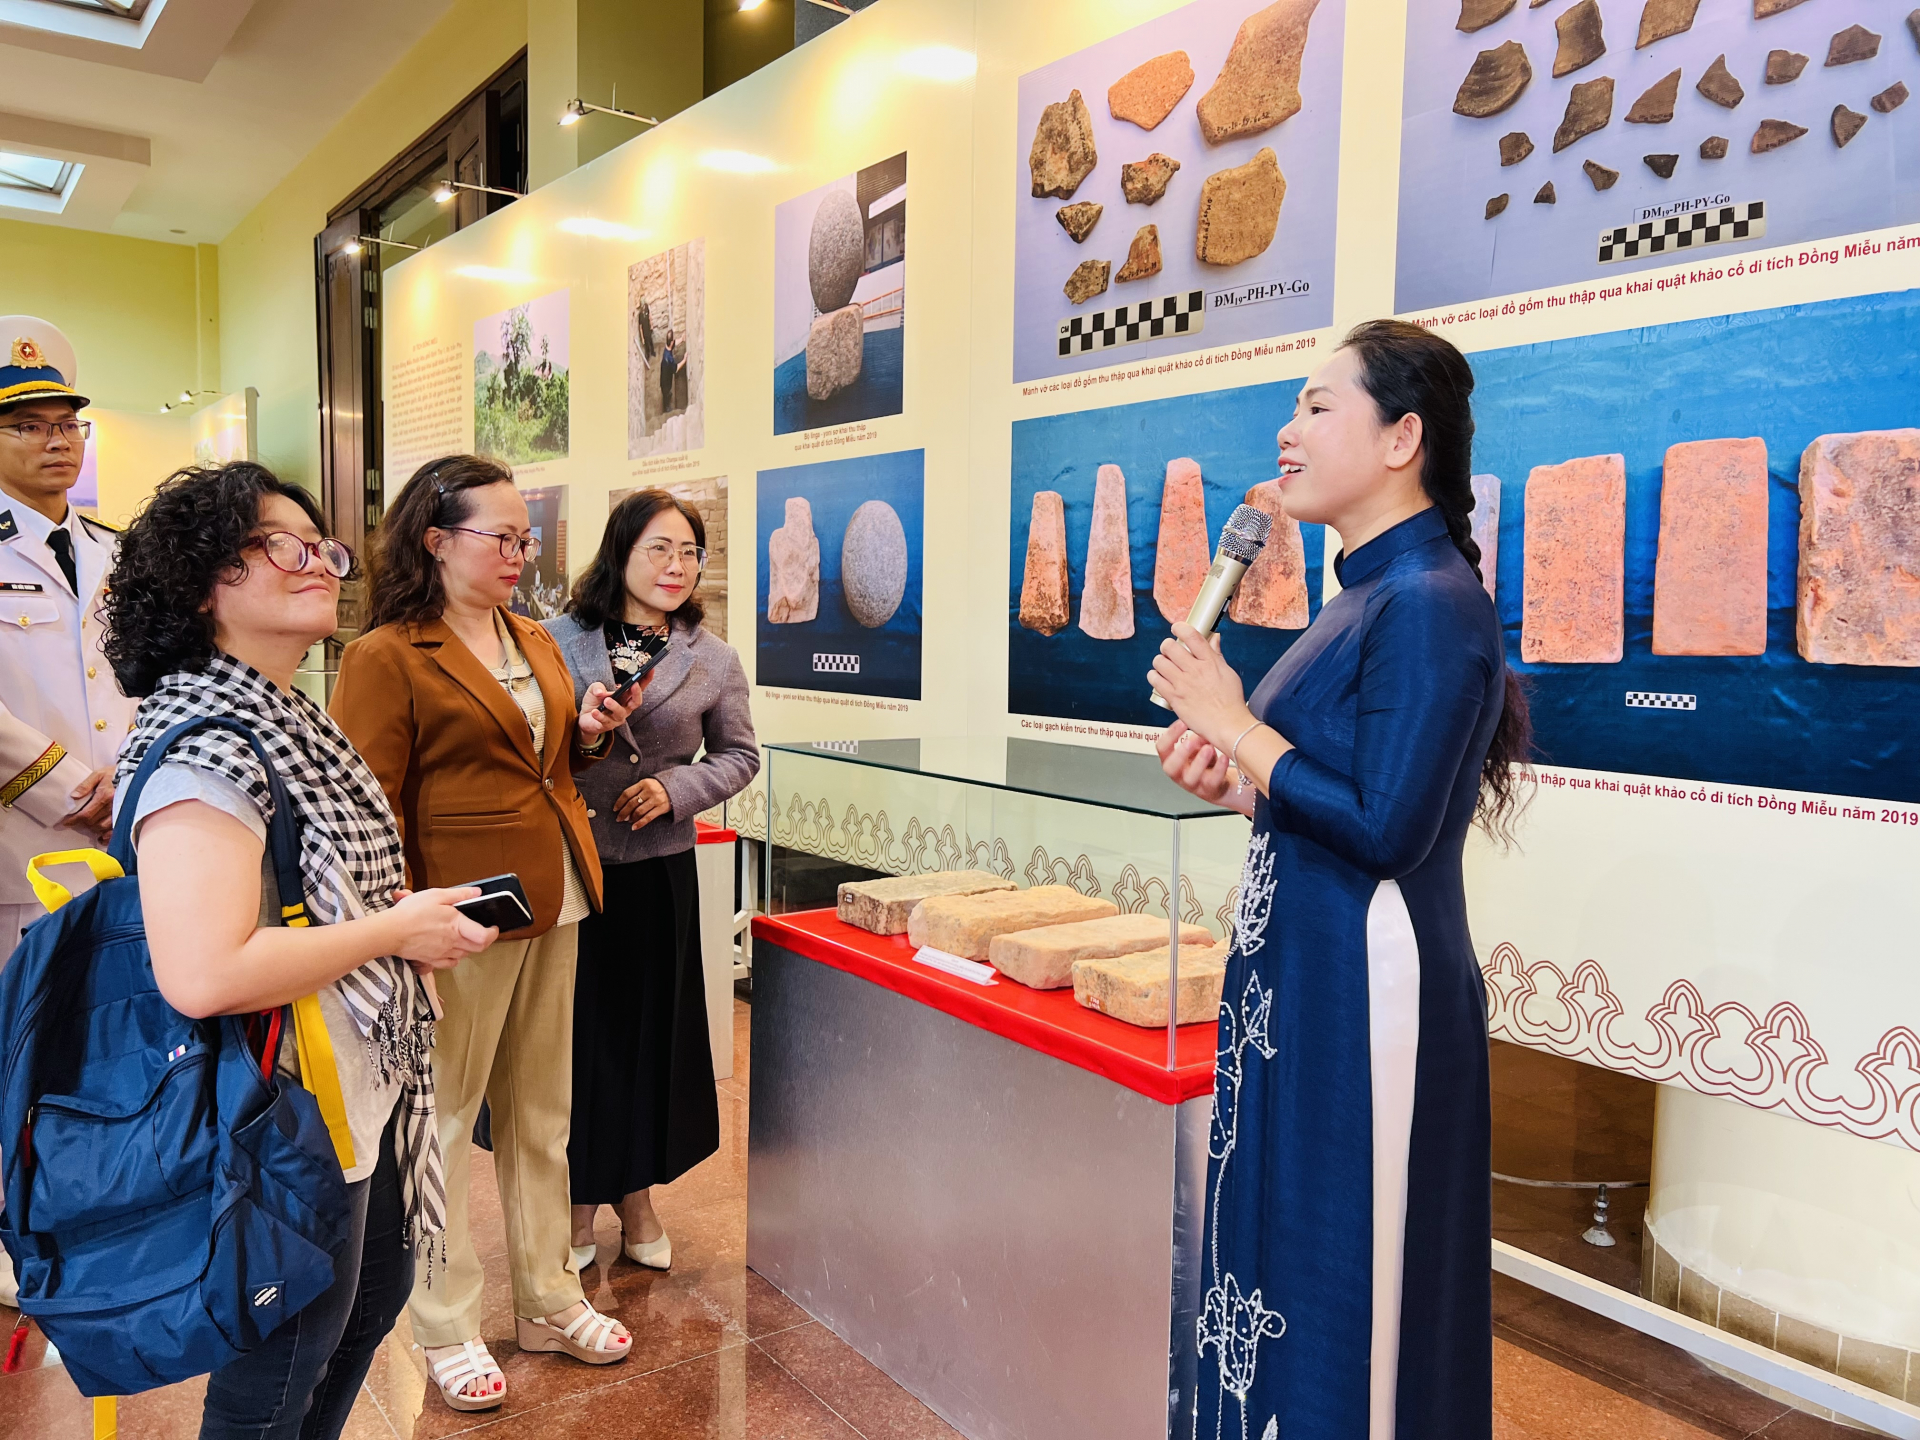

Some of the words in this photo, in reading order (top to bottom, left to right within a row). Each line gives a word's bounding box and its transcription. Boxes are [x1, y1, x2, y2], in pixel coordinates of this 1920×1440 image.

[1602, 235, 1612, 243] CM
[1441, 313, 1455, 325] vỡ
[1458, 310, 1476, 323] các
[1479, 305, 1498, 320] loại
[1501, 300, 1515, 315] đồ
[1519, 296, 1544, 315] gốm
[1547, 297, 1566, 308] thu
[1569, 290, 1596, 305] thập
[1600, 288, 1622, 301] qua
[1626, 279, 1652, 294] khai
[1657, 273, 1686, 292] quật
[1690, 268, 1723, 284] khảo
[1727, 260, 1744, 277] cổ
[1749, 259, 1762, 274] di
[1767, 254, 1793, 271] tích
[1798, 247, 1839, 266] Đồng
[1844, 239, 1881, 258] Miễu
[1887, 236, 1920, 252] năm
[1060, 325, 1070, 334] CM
[1050, 382, 1060, 391] các
[1061, 380, 1072, 391] loại
[1074, 376, 1082, 388] đồ
[1083, 375, 1097, 388] gốm
[1099, 374, 1110, 382] thu
[1111, 371, 1125, 382] thập
[1127, 369, 1140, 380] qua
[1141, 365, 1156, 375] khai
[1157, 362, 1174, 374] quật
[1175, 358, 1193, 371] khảo
[1206, 356, 1213, 365] di
[1214, 353, 1229, 364] tích
[1231, 348, 1252, 361] Đồng
[1254, 344, 1274, 356] Miễu
[1276, 343, 1294, 353] năm
[1296, 337, 1316, 350] 2019
[898, 703, 909, 712] 2019
[1033, 720, 1044, 731] loại
[1044, 722, 1060, 733] gạch
[1060, 721, 1074, 732] kiến
[1074, 724, 1087, 734] trúc
[1088, 726, 1099, 735] thu
[1100, 727, 1114, 739] thập
[1115, 730, 1128, 740] qua
[1129, 730, 1143, 740] khai
[1144, 732, 1160, 743] quật
[1520, 771, 1537, 783] thu
[1541, 773, 1566, 787] thập
[1569, 777, 1591, 790] qua
[1595, 778, 1620, 792] khai
[1623, 782, 1651, 798] quật
[1655, 785, 1686, 801] khảo
[1690, 787, 1706, 802] cổ
[1711, 791, 1723, 804] di
[1727, 793, 1753, 807] tích
[1758, 794, 1797, 815] Đồng
[1802, 799, 1837, 816] Miễu
[1842, 805, 1876, 821] năm
[1881, 809, 1919, 826] 2019
